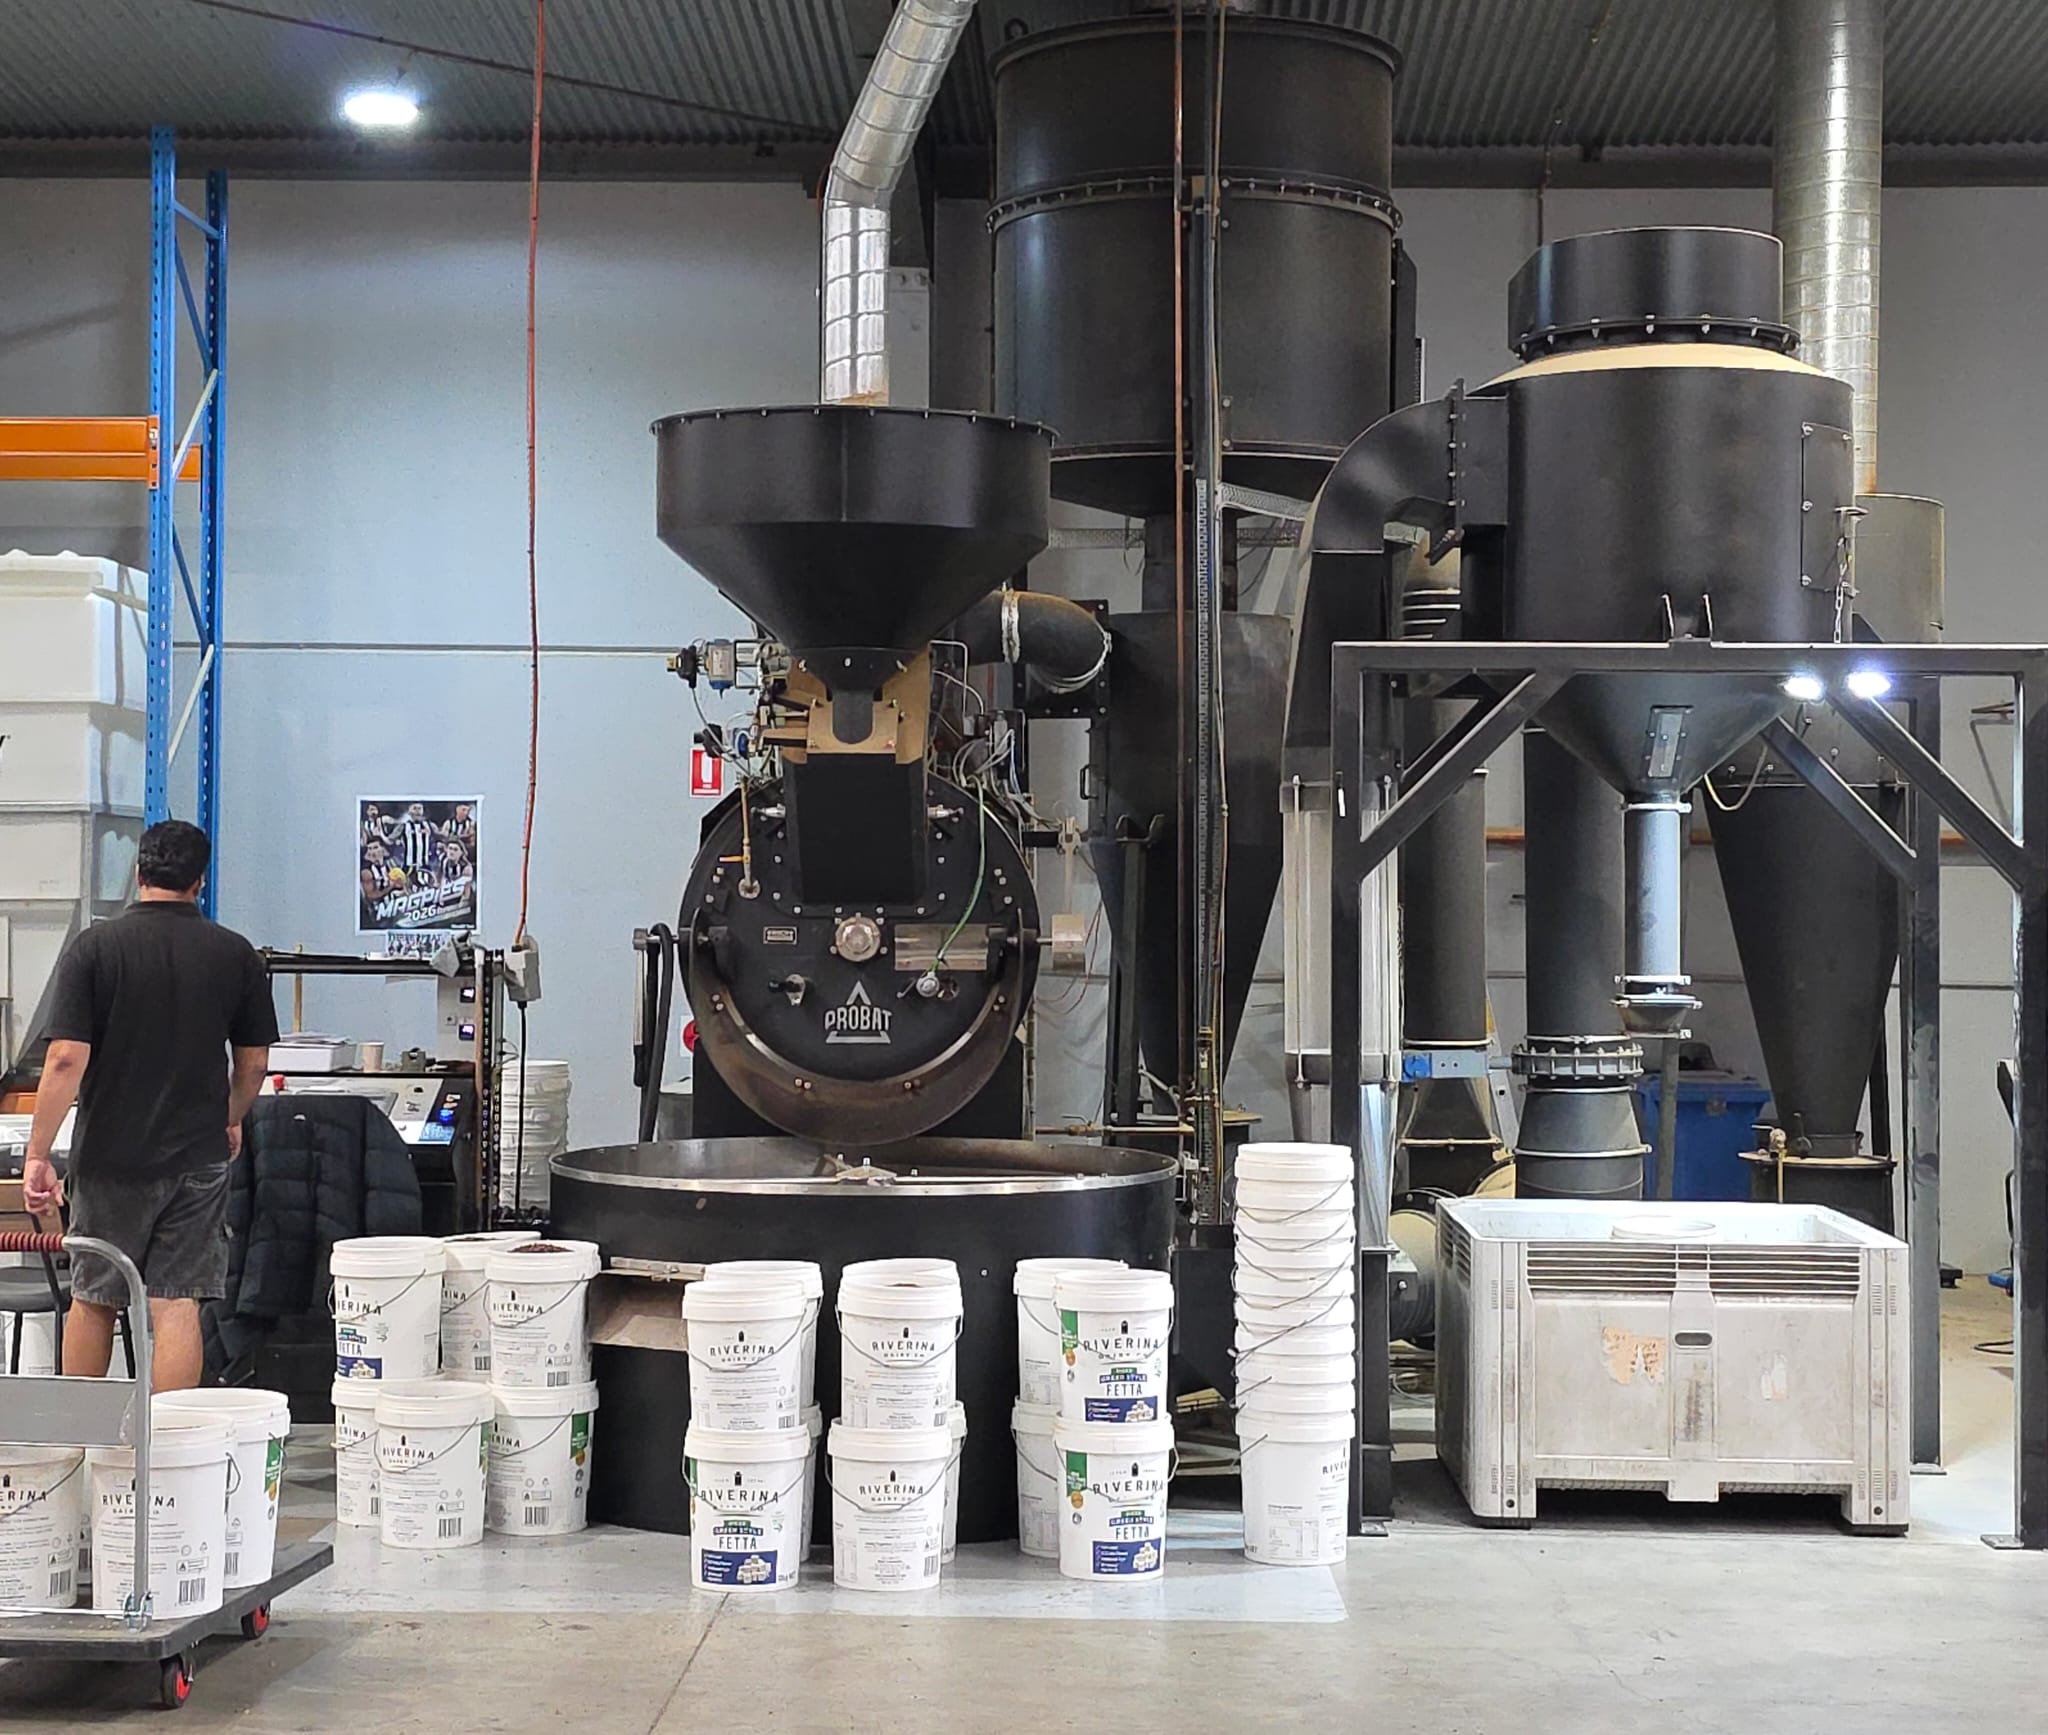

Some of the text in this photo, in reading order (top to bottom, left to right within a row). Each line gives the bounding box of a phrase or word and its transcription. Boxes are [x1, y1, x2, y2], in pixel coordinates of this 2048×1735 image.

[375, 876, 472, 920] MAGPIES
[404, 905, 437, 921] 2026
[824, 1005, 892, 1031] PROBAT
[710, 1345, 775, 1356] RIVERINA
[871, 1341, 935, 1351] RIVERINA
[1083, 1337, 1159, 1351] RIVERINA
[1106, 1383, 1143, 1396] FETTA
[382, 1447, 435, 1461] RIVERINA
[859, 1484, 924, 1495] RIVERINA
[1092, 1479, 1164, 1494] RIVERINA
[102, 1494, 175, 1508] RIVENA
[701, 1489, 779, 1503] RIVERINA
[1115, 1526, 1150, 1540] FETTA
[719, 1536, 757, 1549] FETTA
